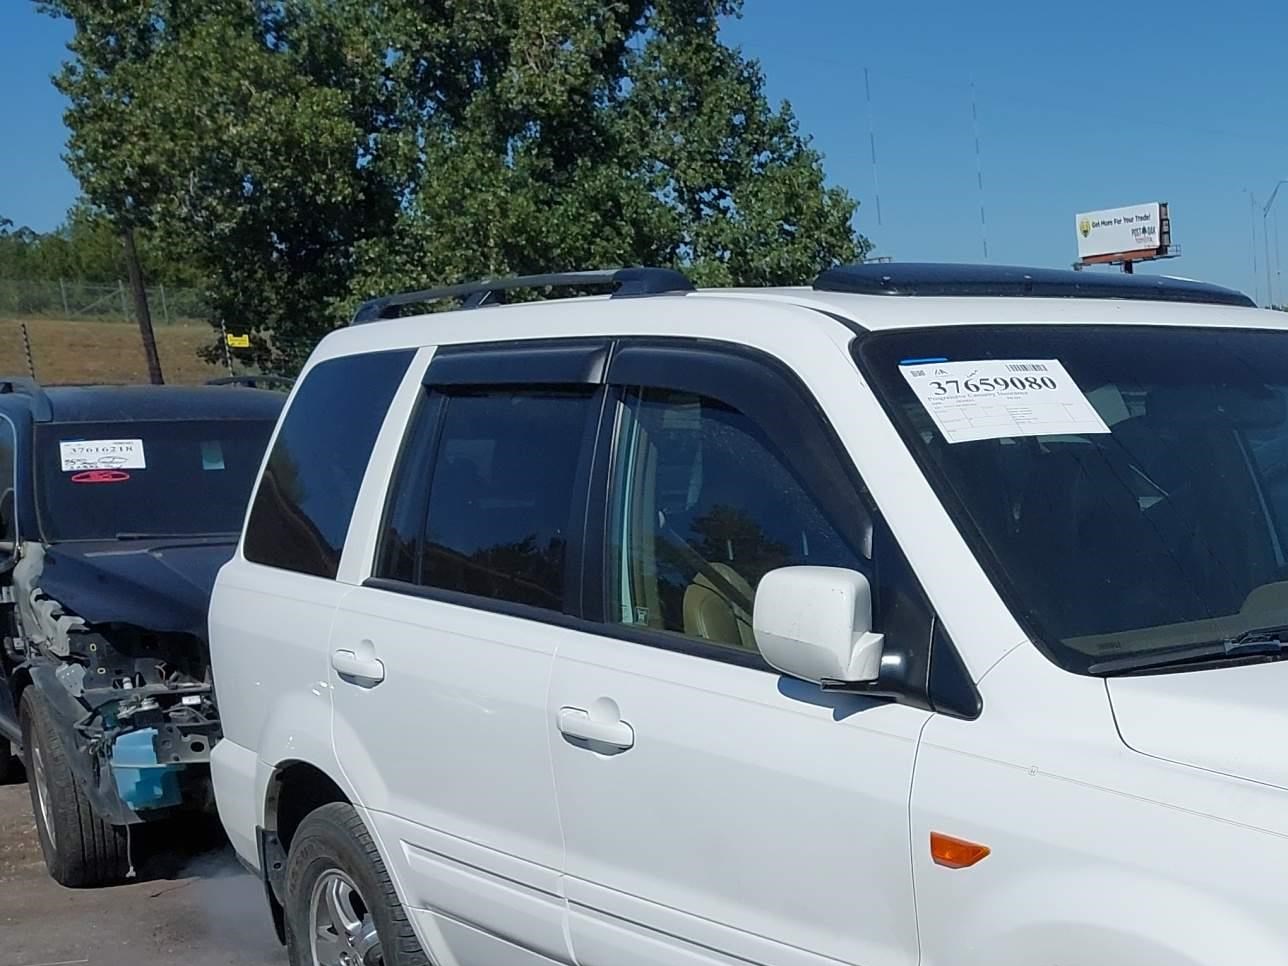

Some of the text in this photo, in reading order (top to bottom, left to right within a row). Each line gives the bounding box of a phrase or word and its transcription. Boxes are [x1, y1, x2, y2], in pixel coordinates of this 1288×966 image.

[1091, 220, 1100, 228] Get
[1114, 217, 1122, 225] For
[1123, 215, 1134, 223] Your
[928, 375, 1057, 396] 37659080
